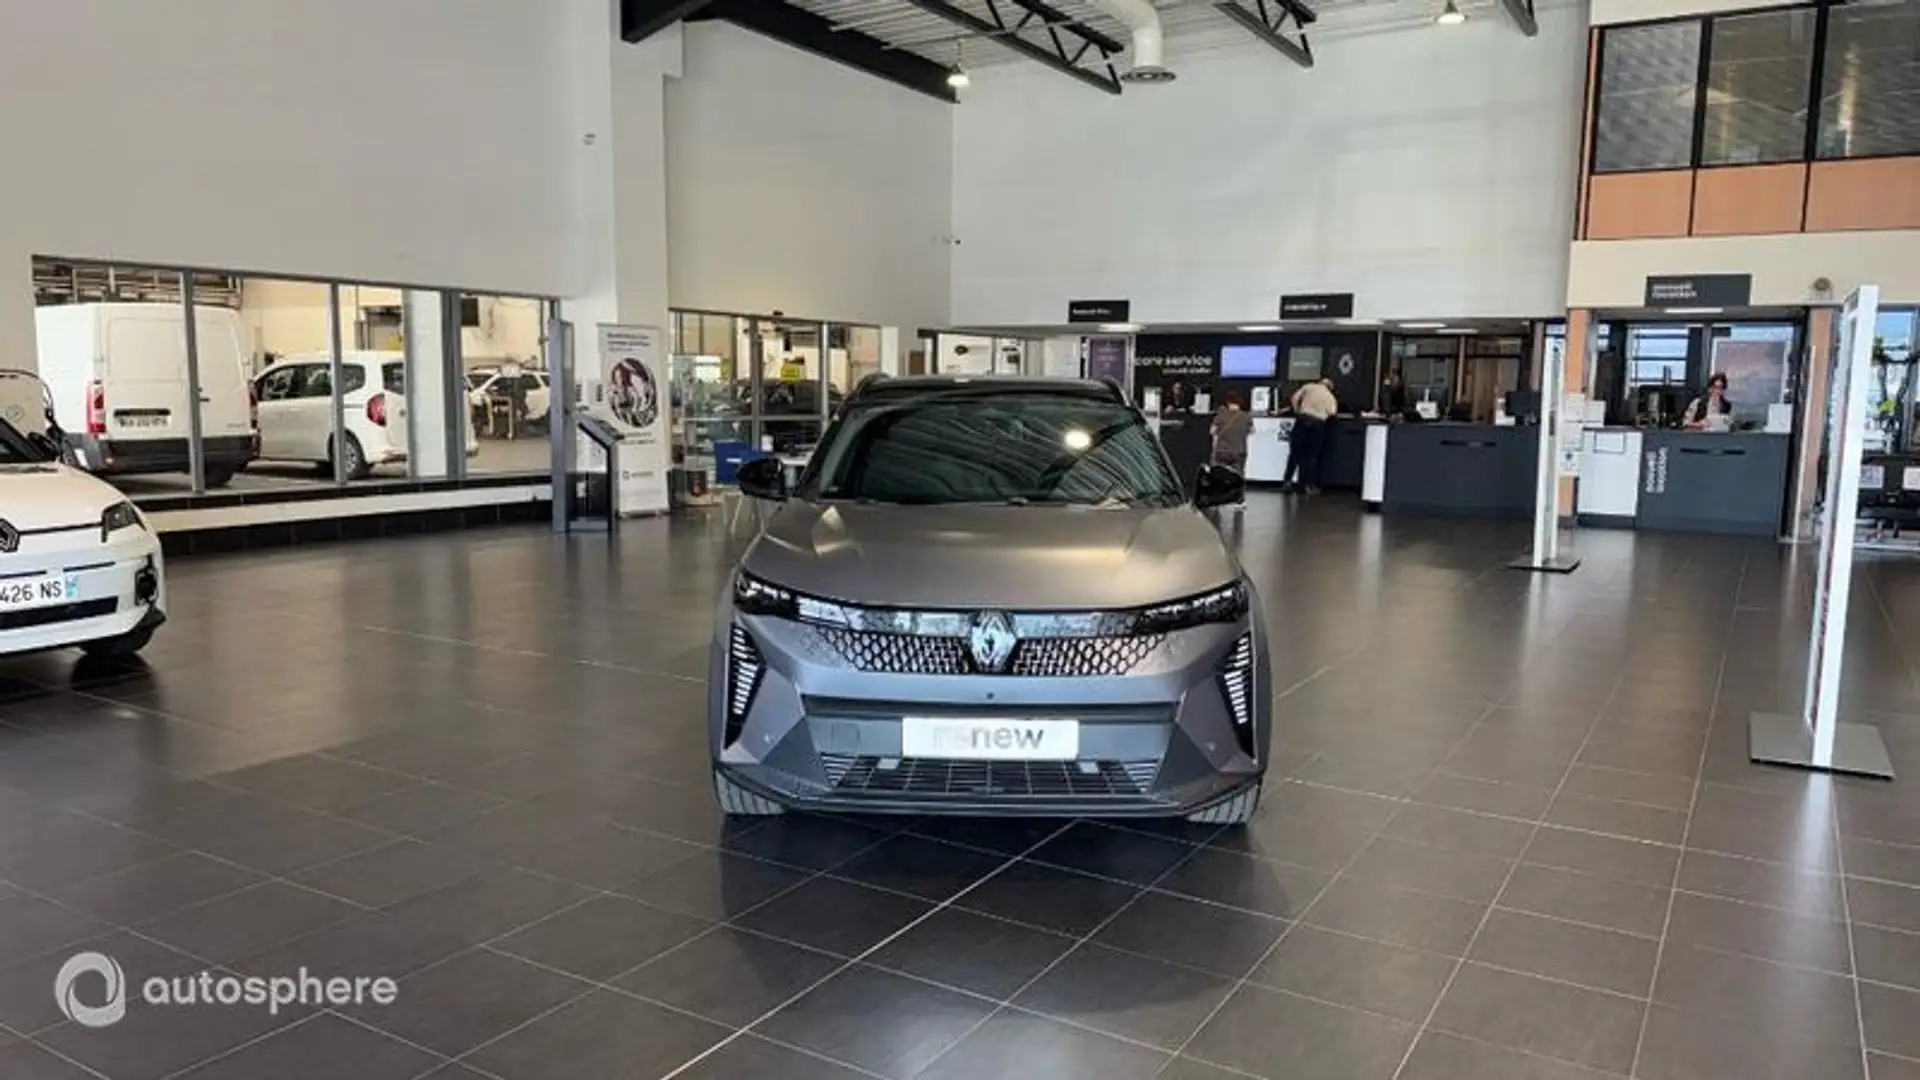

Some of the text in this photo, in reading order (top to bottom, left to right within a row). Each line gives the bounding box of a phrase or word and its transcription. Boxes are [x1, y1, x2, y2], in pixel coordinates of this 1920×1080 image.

[1166, 354, 1213, 367] service
[40, 580, 62, 599] NS
[933, 726, 1044, 750] renew
